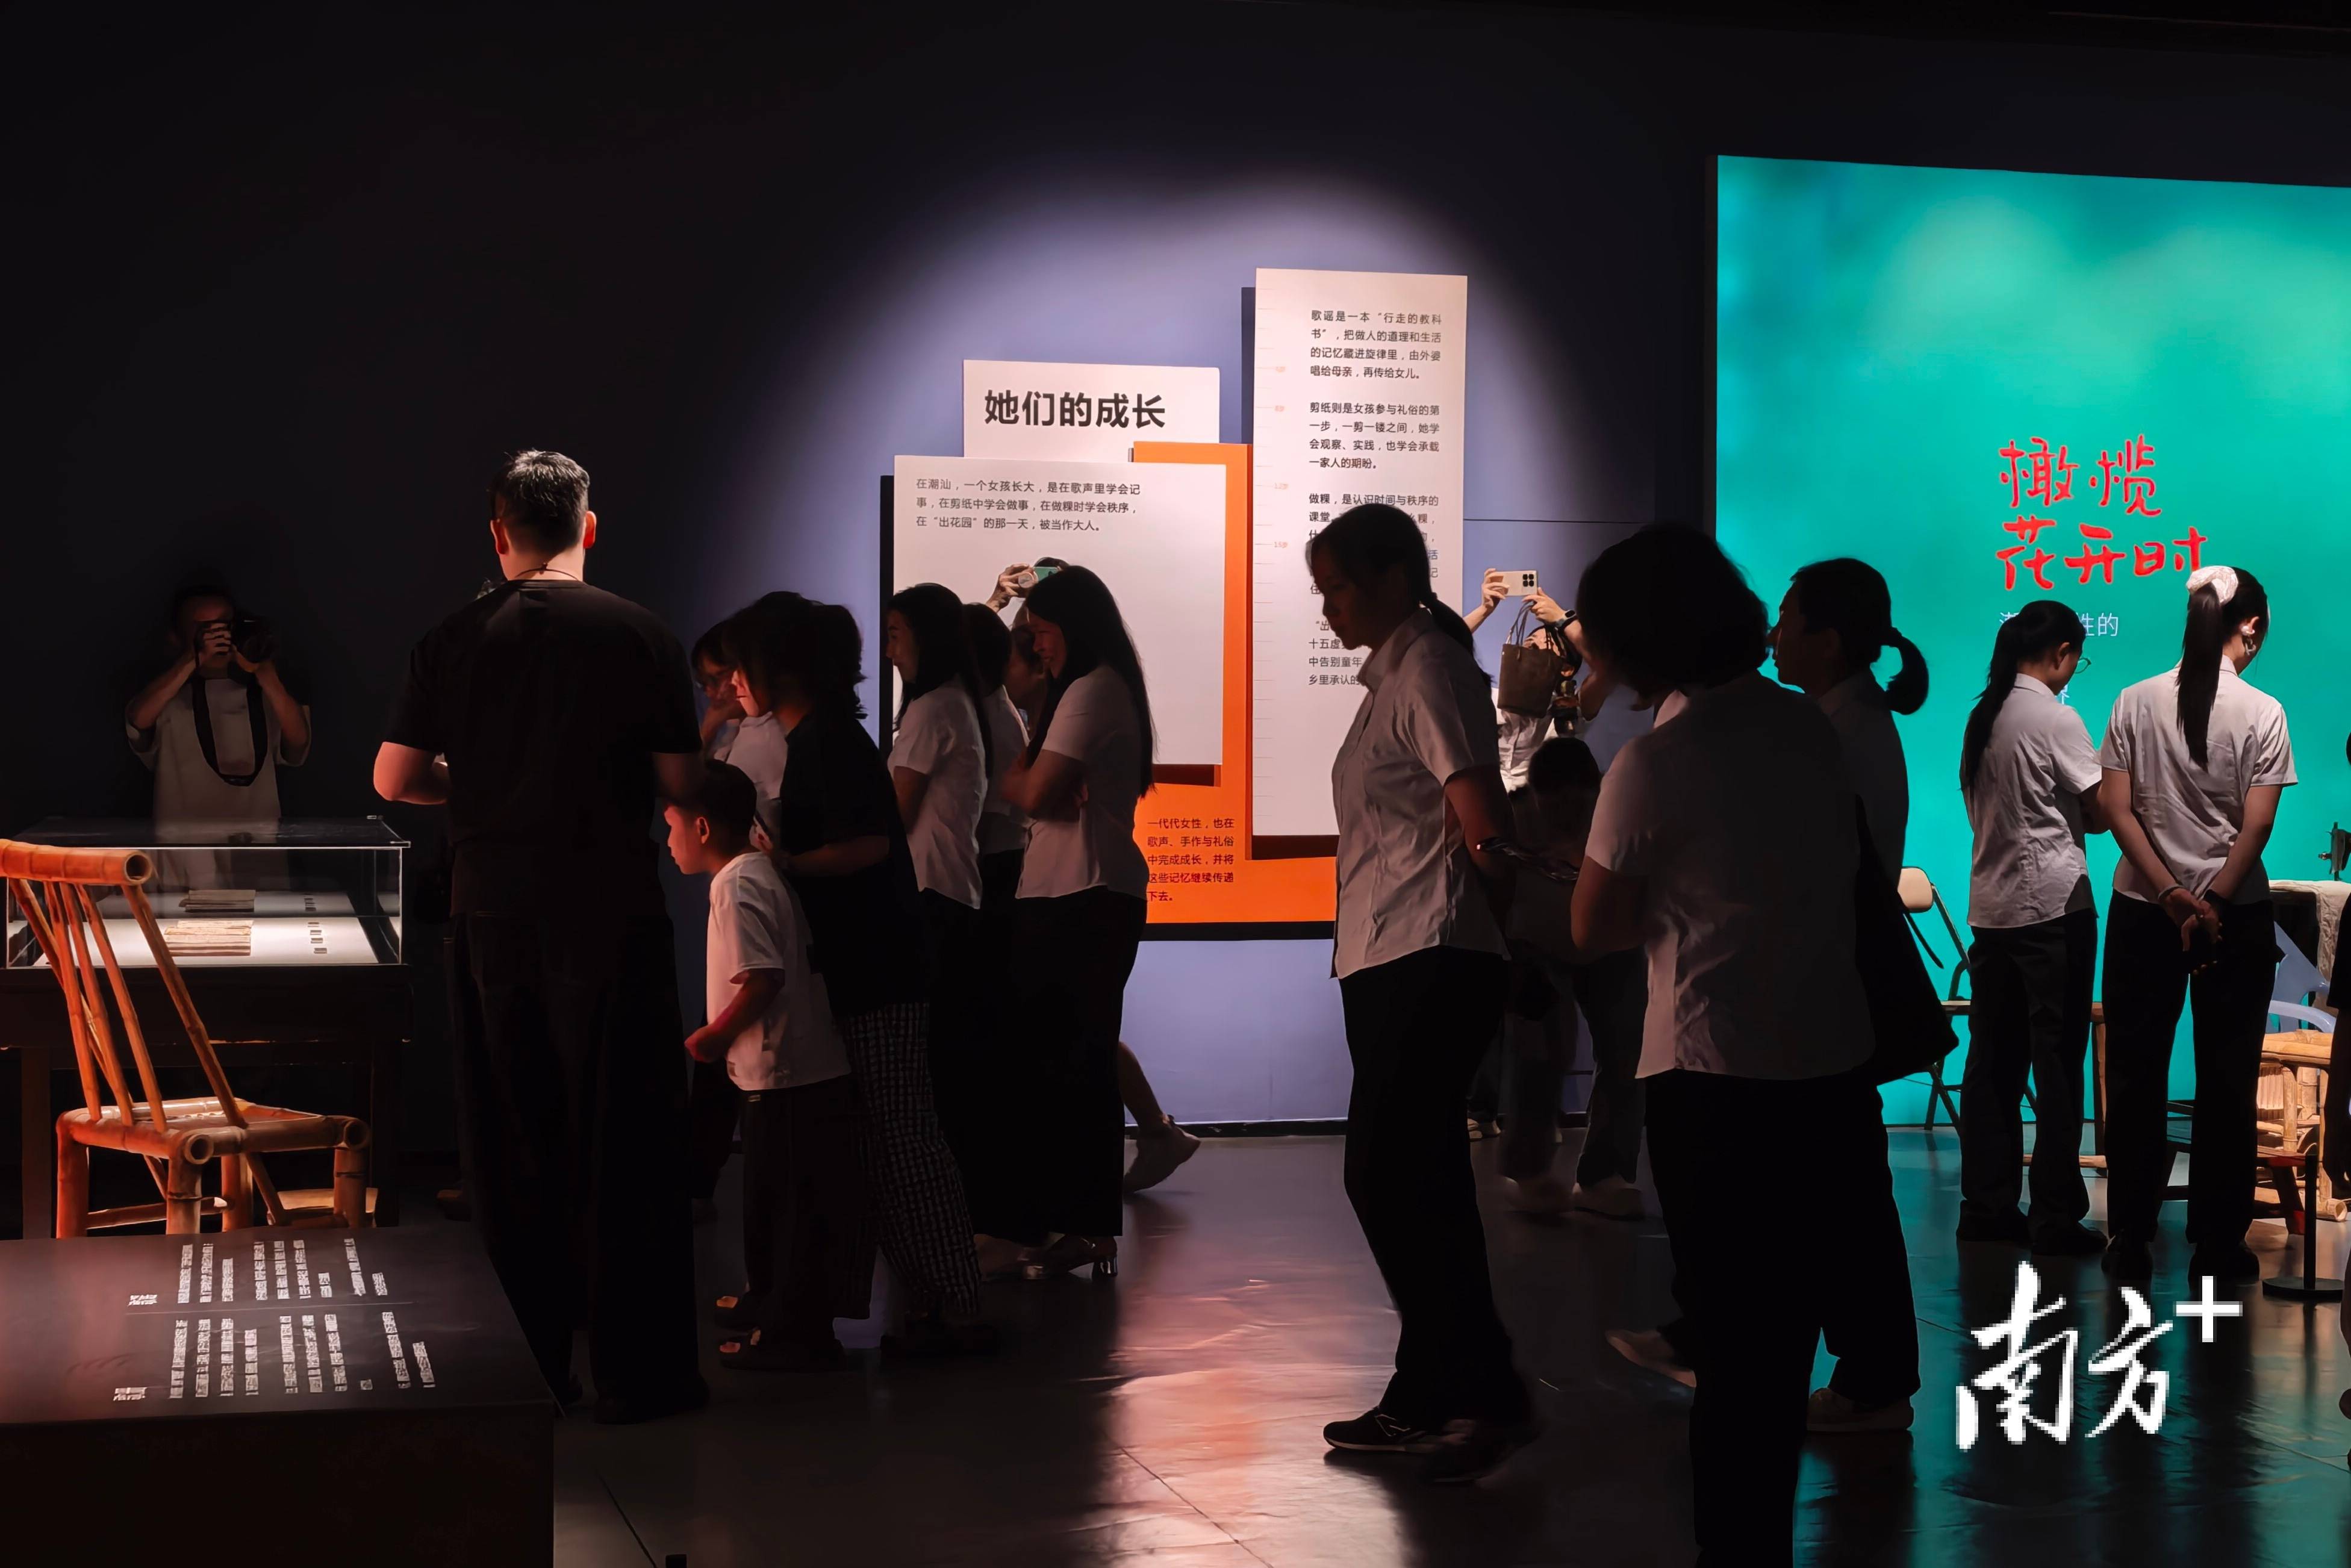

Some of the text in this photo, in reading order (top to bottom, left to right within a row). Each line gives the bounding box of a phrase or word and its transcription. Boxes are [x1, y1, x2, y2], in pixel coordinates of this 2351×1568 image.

[1311, 329, 1441, 343] 书”，把做人的道理和生活
[1310, 366, 1419, 379] 唱给母亲，再传给女儿。
[985, 390, 1165, 428] 她们的成长
[1310, 402, 1439, 415] 剪纸则是女孩参与礼俗的第
[1309, 439, 1439, 452] 会观察、实践，也学会承载
[1309, 458, 1376, 469] 一家人的期盼。
[1999, 434, 2161, 517] 橄榄
[916, 478, 1141, 495] 在潮汕，一个女孩长大，是在歌声里学会记
[916, 497, 1136, 514] 事，在剪纸中学会做事，在做粿时学会秩序，
[916, 516, 1100, 532] 在“出花园”的那一天，被当作大人。
[1995, 514, 2208, 591] 花开时
[1309, 638, 1346, 649] 十五虚
[1147, 836, 1234, 847] 歌声、手作与礼俗
[1147, 854, 1234, 865] 中完成成长，并将
[1147, 891, 1173, 902] 下去。
